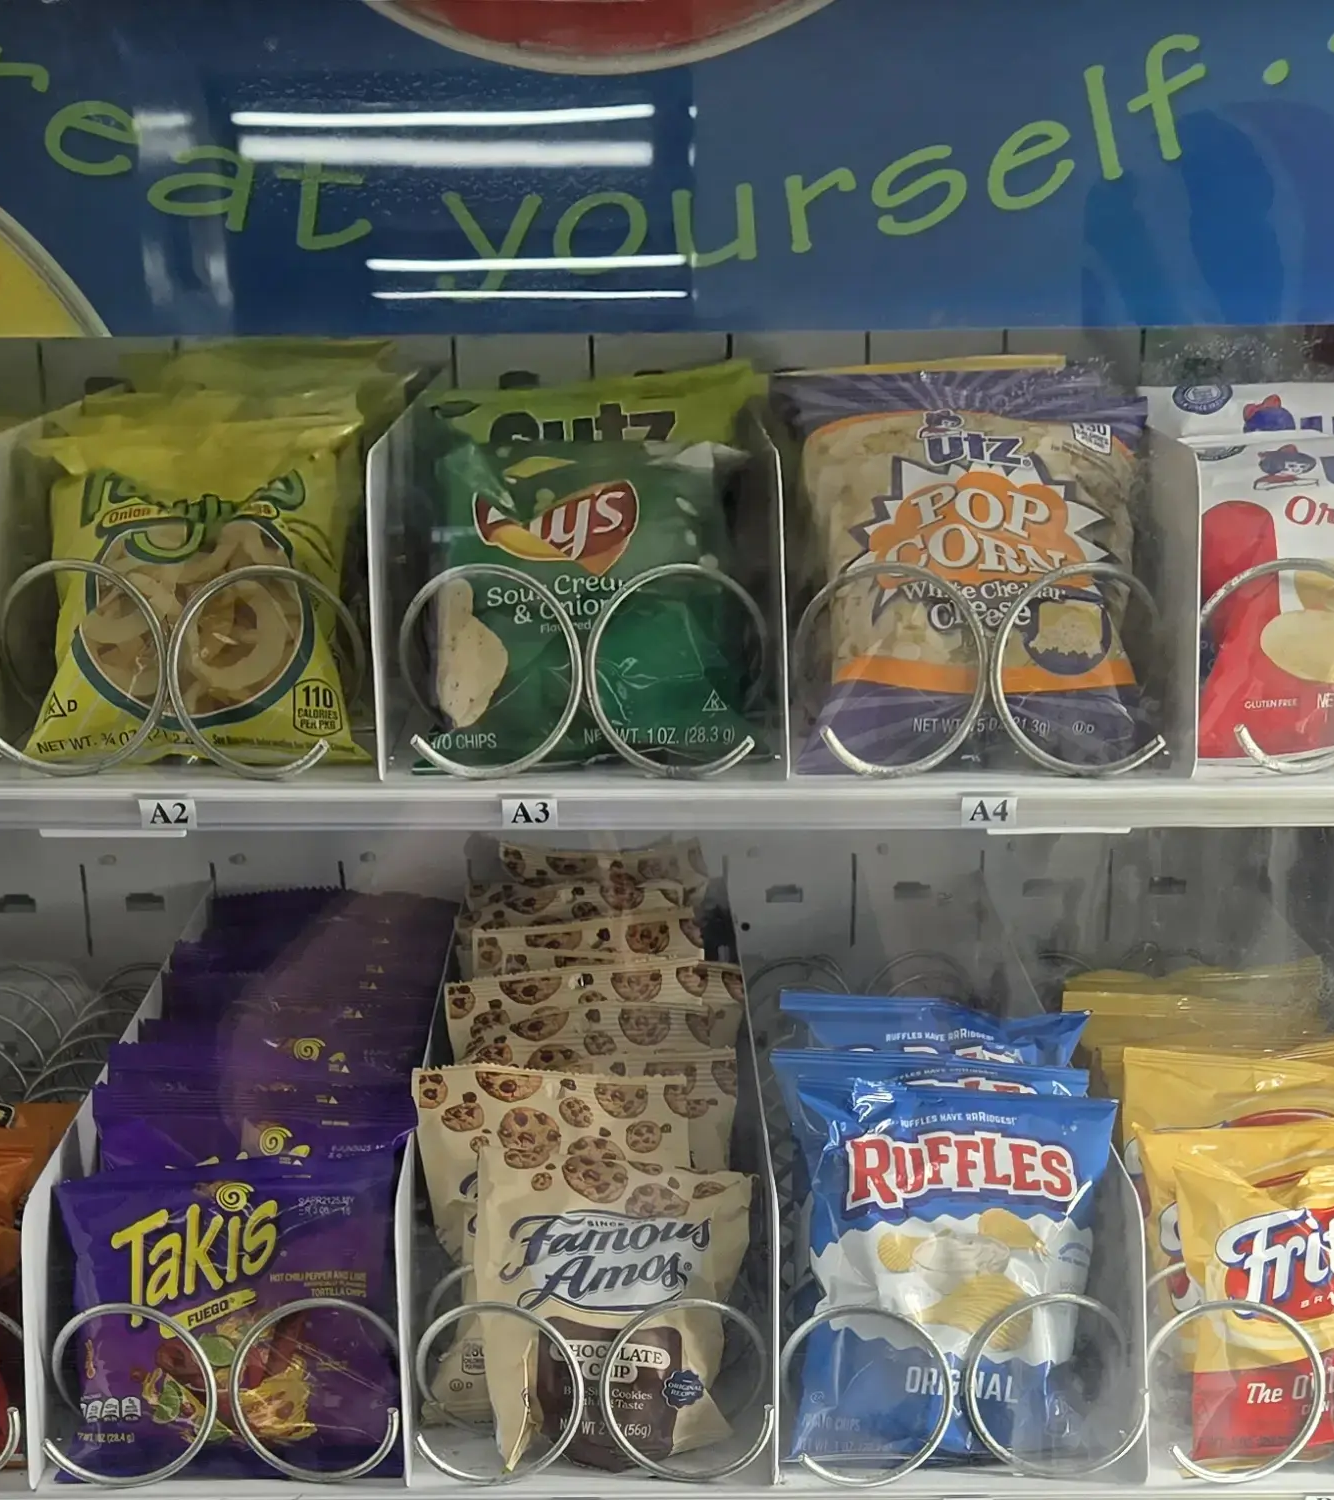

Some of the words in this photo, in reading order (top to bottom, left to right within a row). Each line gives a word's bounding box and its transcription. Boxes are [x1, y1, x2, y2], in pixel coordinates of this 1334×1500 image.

[434, 34, 1207, 293] yourself
[108, 505, 151, 525] Onion
[911, 484, 1051, 539] POP
[884, 522, 1067, 578] CORN
[514, 605, 532, 625] &
[301, 687, 334, 708] 110
[1244, 699, 1273, 710] GLUTEN
[1274, 698, 1298, 708] FREE
[297, 708, 338, 722] CALORIES
[912, 717, 938, 733] NET
[36, 738, 67, 754] NET
[71, 735, 97, 751] WT.
[455, 734, 497, 749] CHIPS
[149, 803, 190, 826] A2
[511, 802, 551, 824] A3
[968, 801, 1009, 823] A4
[885, 1031, 923, 1042] RUFFLES
[924, 1031, 946, 1042] HAVE
[939, 1112, 963, 1122] HAVE
[848, 1136, 1075, 1206] RUFFLES
[500, 1214, 712, 1282] Famous
[110, 1199, 279, 1328] Takis
[517, 1251, 689, 1310] Amos
[186, 1300, 230, 1326] FUEGO
[668, 1382, 702, 1392] ORIGINAL
[670, 1388, 697, 1397] RECIPE
[905, 1365, 1018, 1404] ORIGNAL
[1246, 1382, 1283, 1405] The
[611, 1389, 653, 1401] Cookies
[616, 1399, 644, 1411] Taste
[623, 1423, 652, 1438] (56g)
